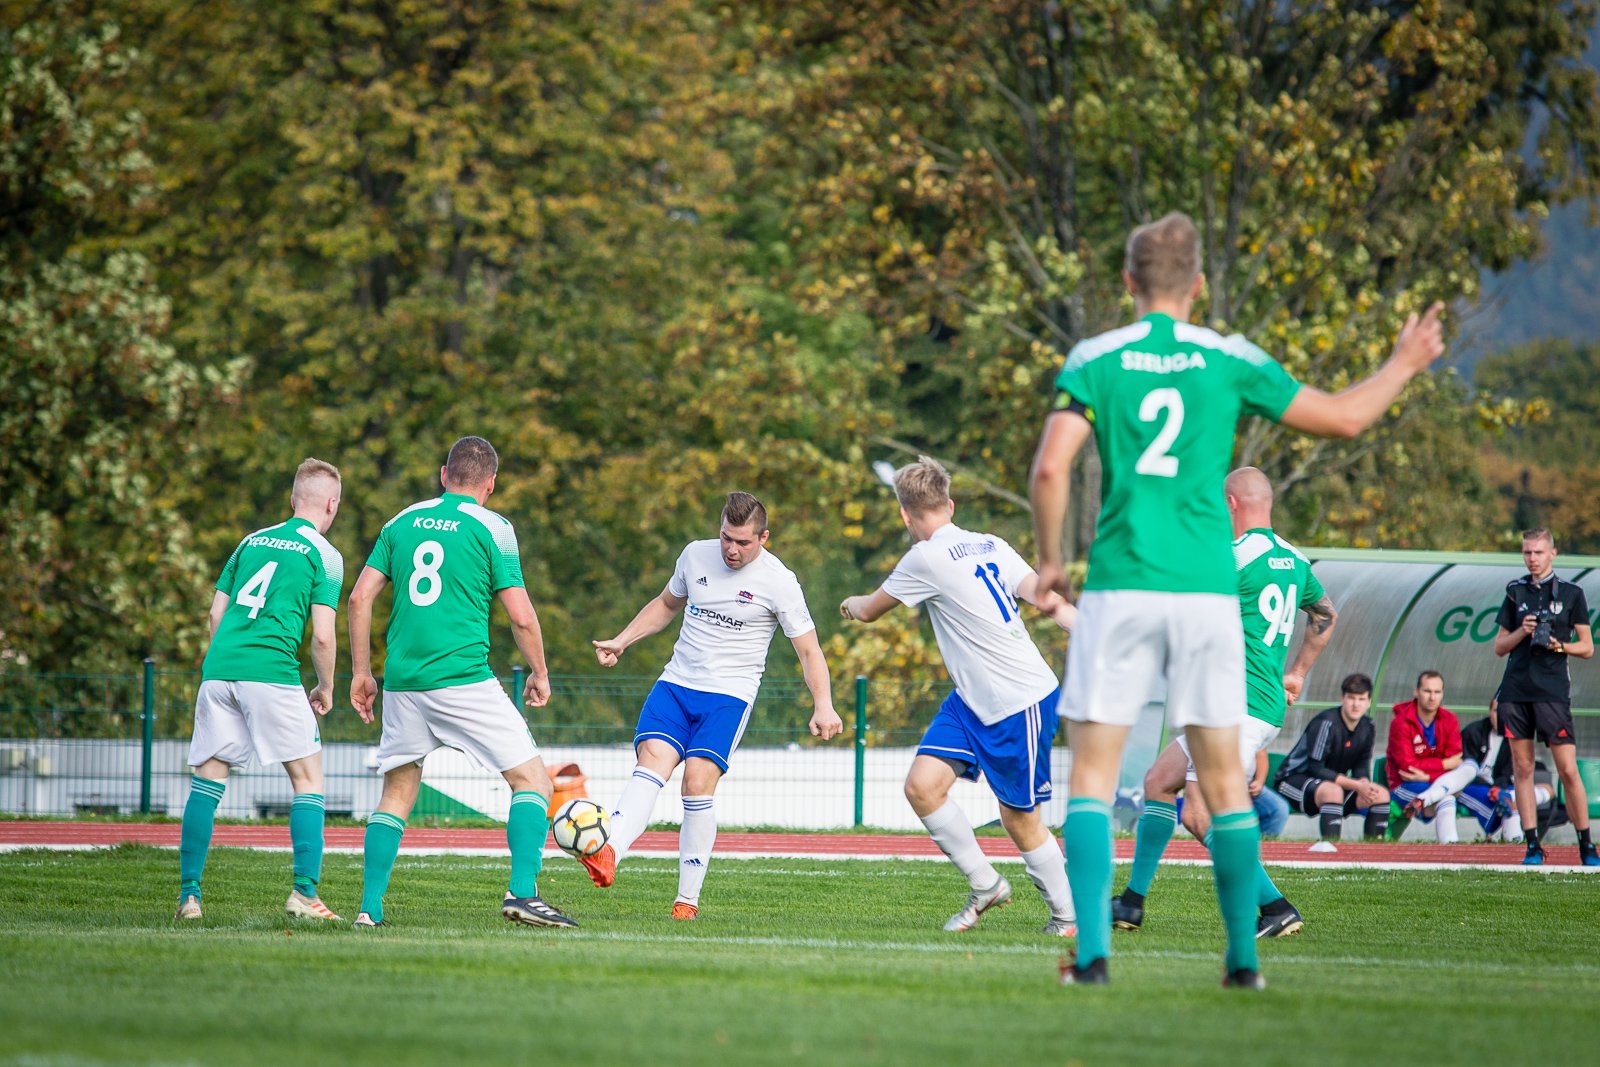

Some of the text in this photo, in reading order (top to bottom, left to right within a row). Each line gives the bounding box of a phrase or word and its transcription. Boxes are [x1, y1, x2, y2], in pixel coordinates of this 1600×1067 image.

[1135, 387, 1184, 478] 2
[413, 517, 461, 532] KOSEK
[235, 561, 278, 620] 4
[409, 540, 444, 607] 8
[700, 608, 744, 628] PONAR
[1258, 583, 1298, 647] 94
